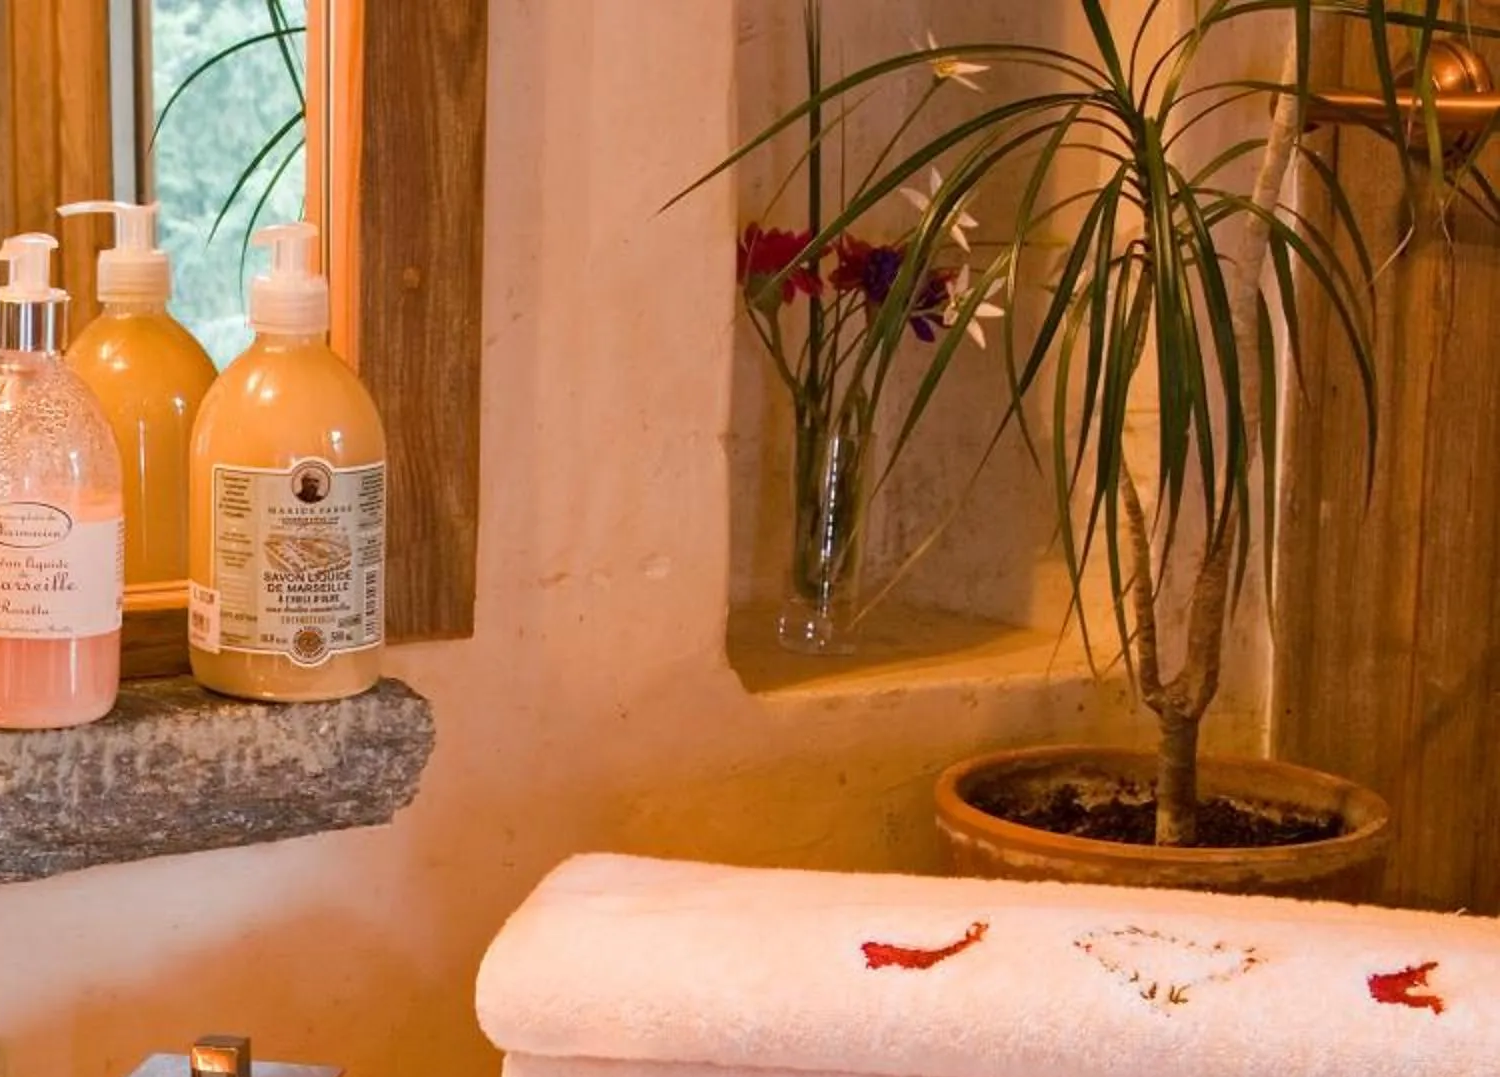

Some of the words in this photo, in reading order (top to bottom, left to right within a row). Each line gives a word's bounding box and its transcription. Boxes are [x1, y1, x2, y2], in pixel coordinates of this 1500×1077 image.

[263, 571, 305, 583] SAVON
[307, 570, 352, 583] LIQUIDE
[266, 583, 283, 593] DE
[286, 581, 350, 593] MARSEILLE
